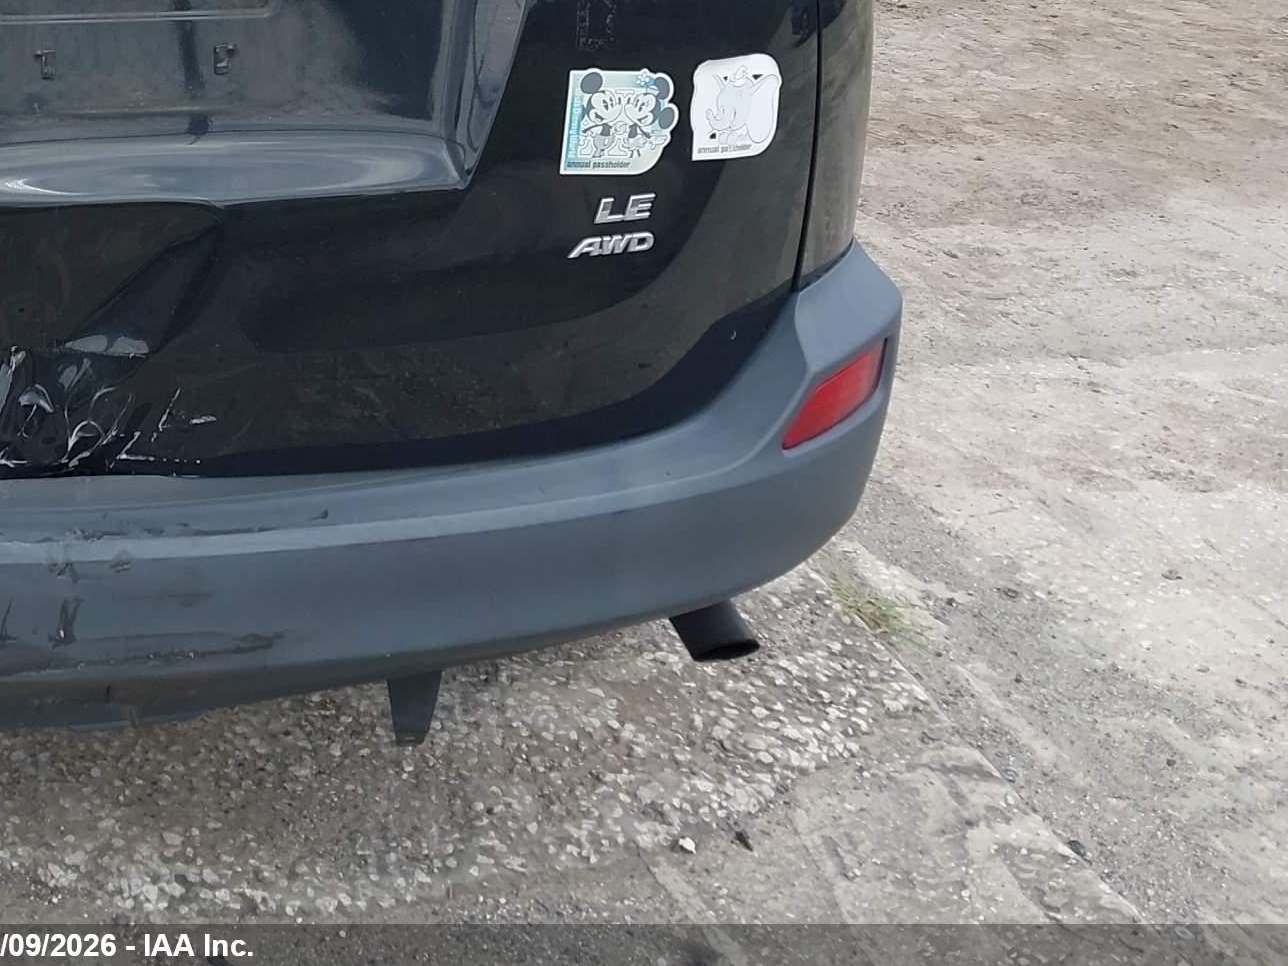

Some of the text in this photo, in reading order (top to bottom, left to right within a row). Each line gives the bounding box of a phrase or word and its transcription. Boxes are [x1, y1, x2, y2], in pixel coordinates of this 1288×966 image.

[566, 160, 631, 170] annual passholder
[593, 193, 656, 224] LE
[567, 231, 655, 259] AWD
